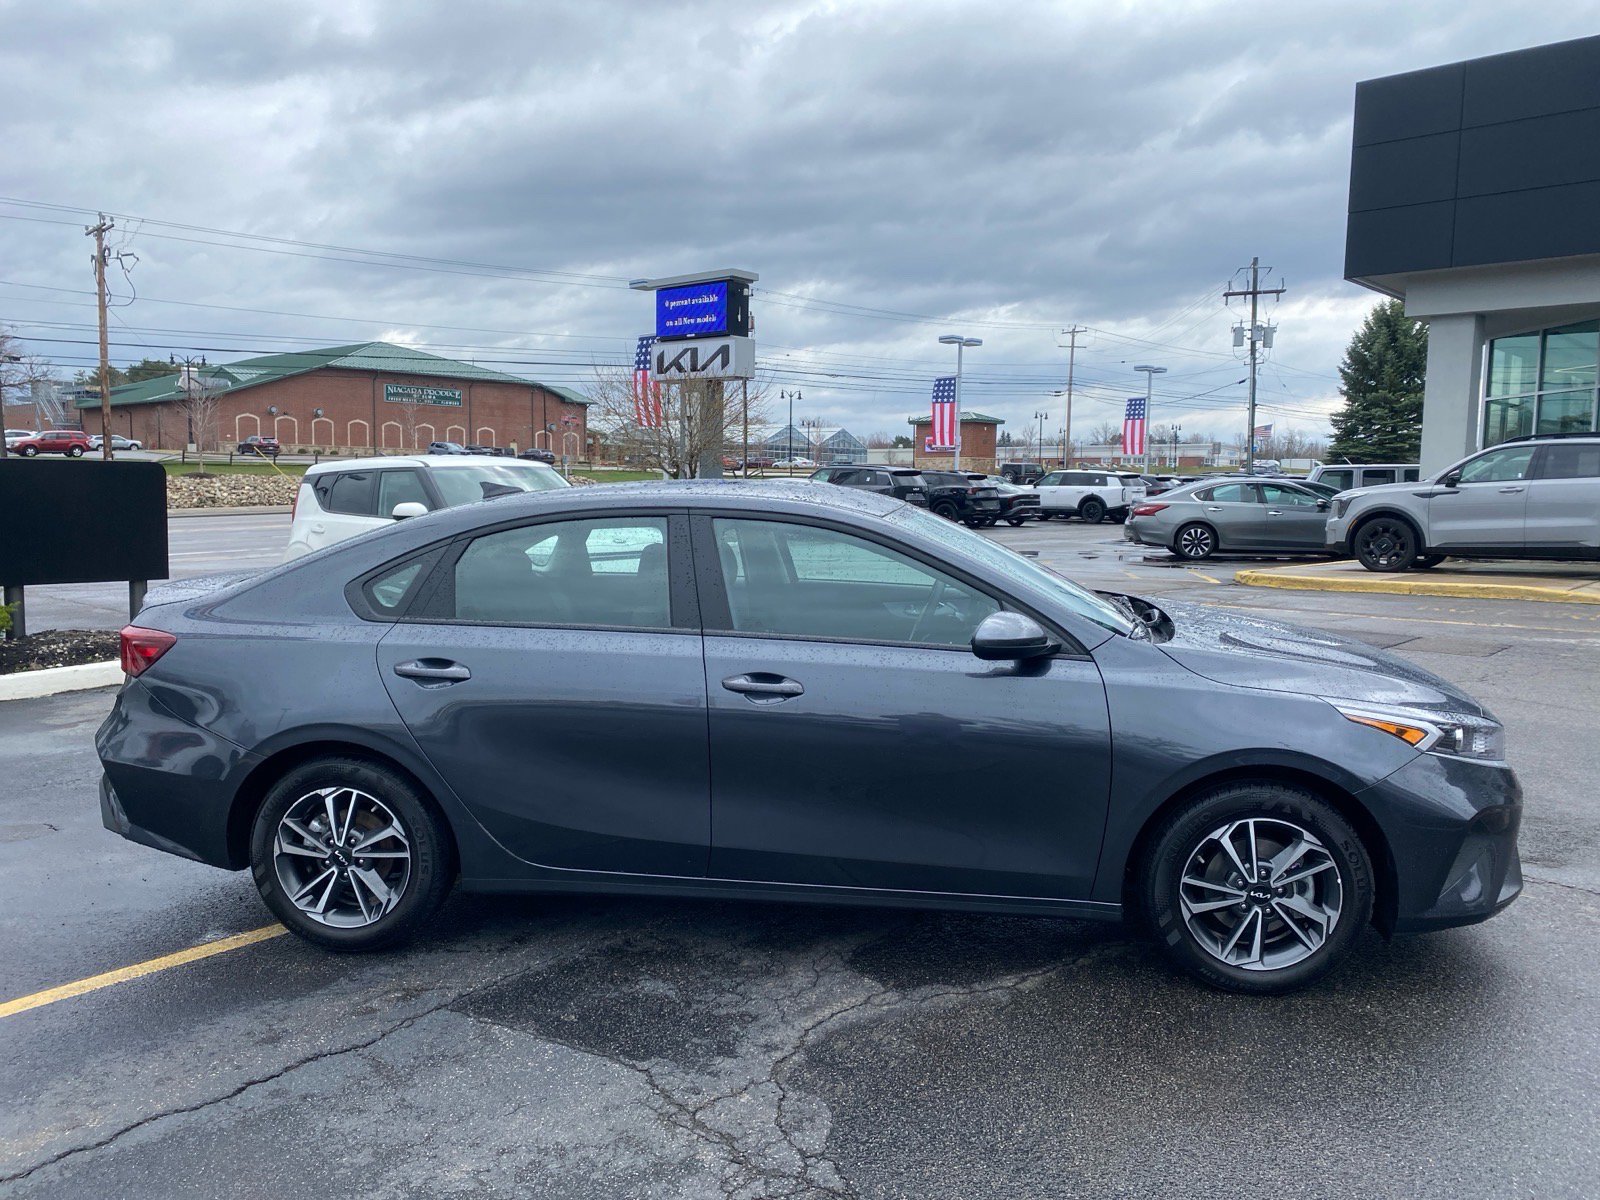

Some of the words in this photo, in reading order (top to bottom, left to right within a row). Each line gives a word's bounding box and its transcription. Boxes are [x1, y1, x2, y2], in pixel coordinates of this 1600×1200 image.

[670, 298, 691, 310] percent
[691, 294, 718, 305] available
[674, 318, 682, 326] all
[682, 316, 695, 325] New
[696, 313, 717, 324] models
[656, 344, 730, 375] KIA
[387, 385, 422, 395] NIAGARA
[423, 388, 461, 399] PRODUCE
